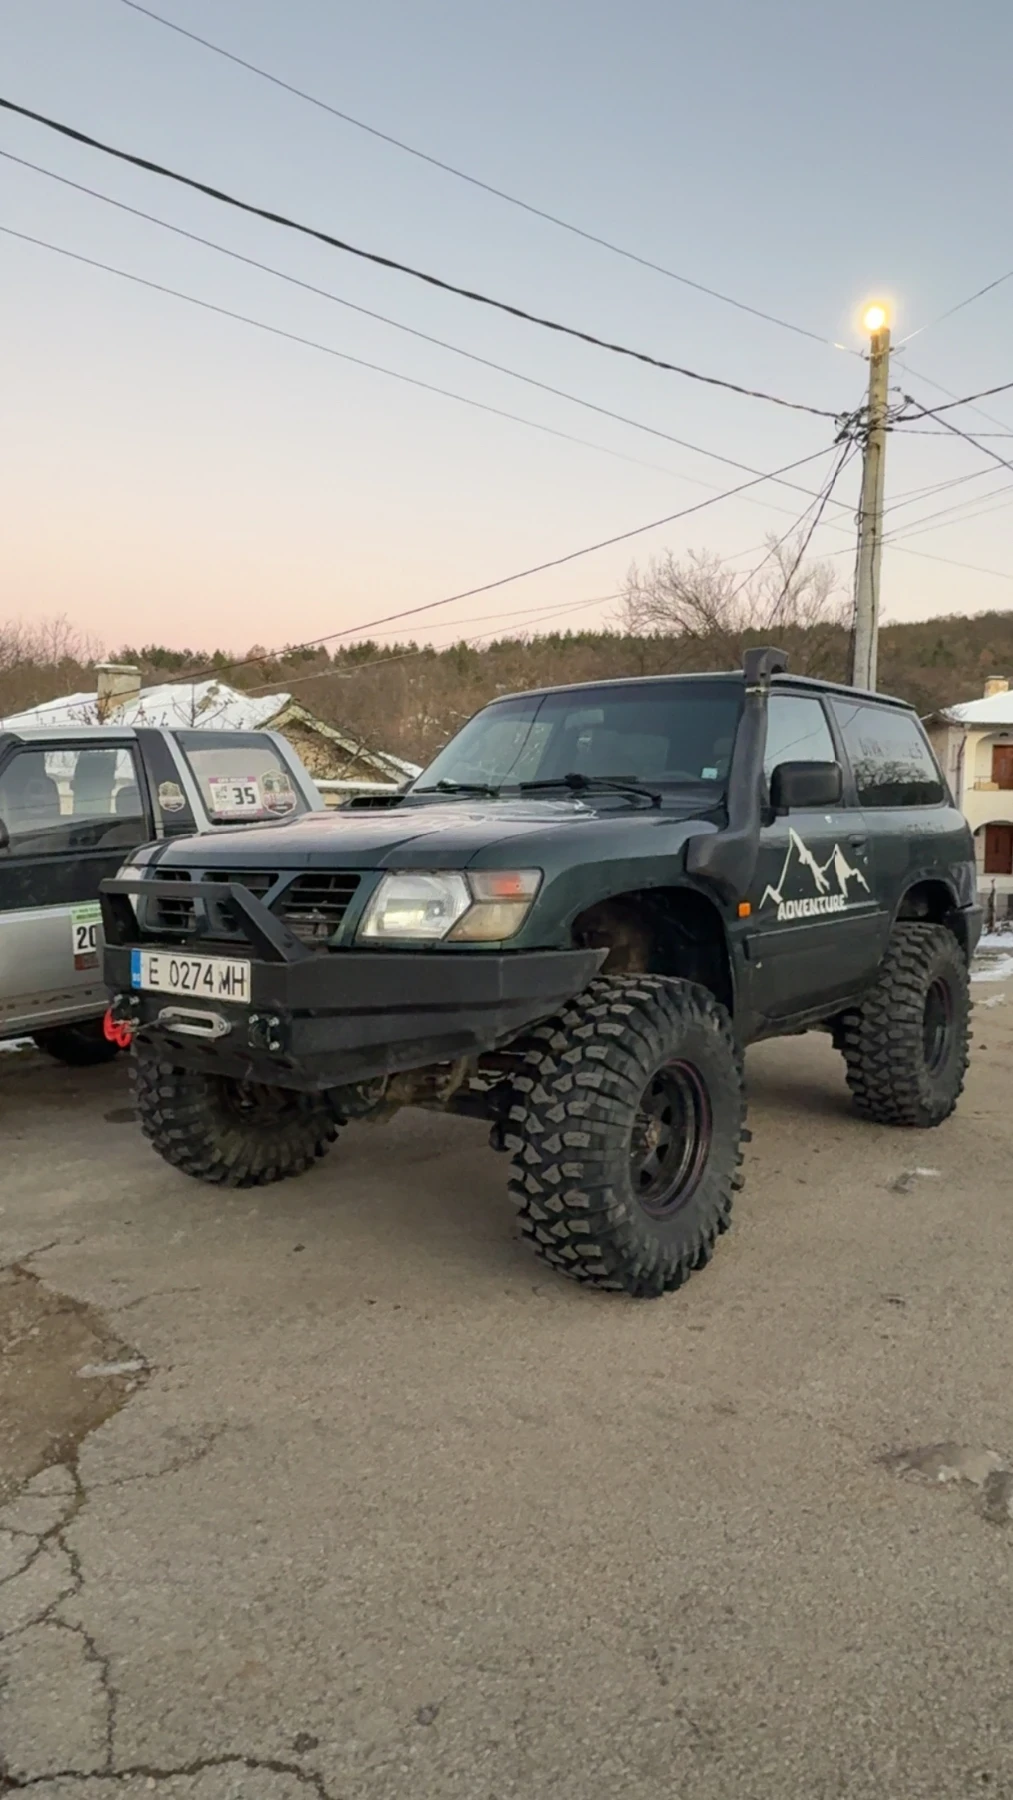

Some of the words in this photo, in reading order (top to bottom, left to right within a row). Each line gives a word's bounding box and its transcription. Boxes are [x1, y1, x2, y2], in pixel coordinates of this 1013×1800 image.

[232, 787, 256, 805] 35
[777, 894, 847, 921] ADVENTURE
[149, 957, 159, 985] E
[169, 960, 214, 993] 0274
[219, 965, 244, 997] MH
